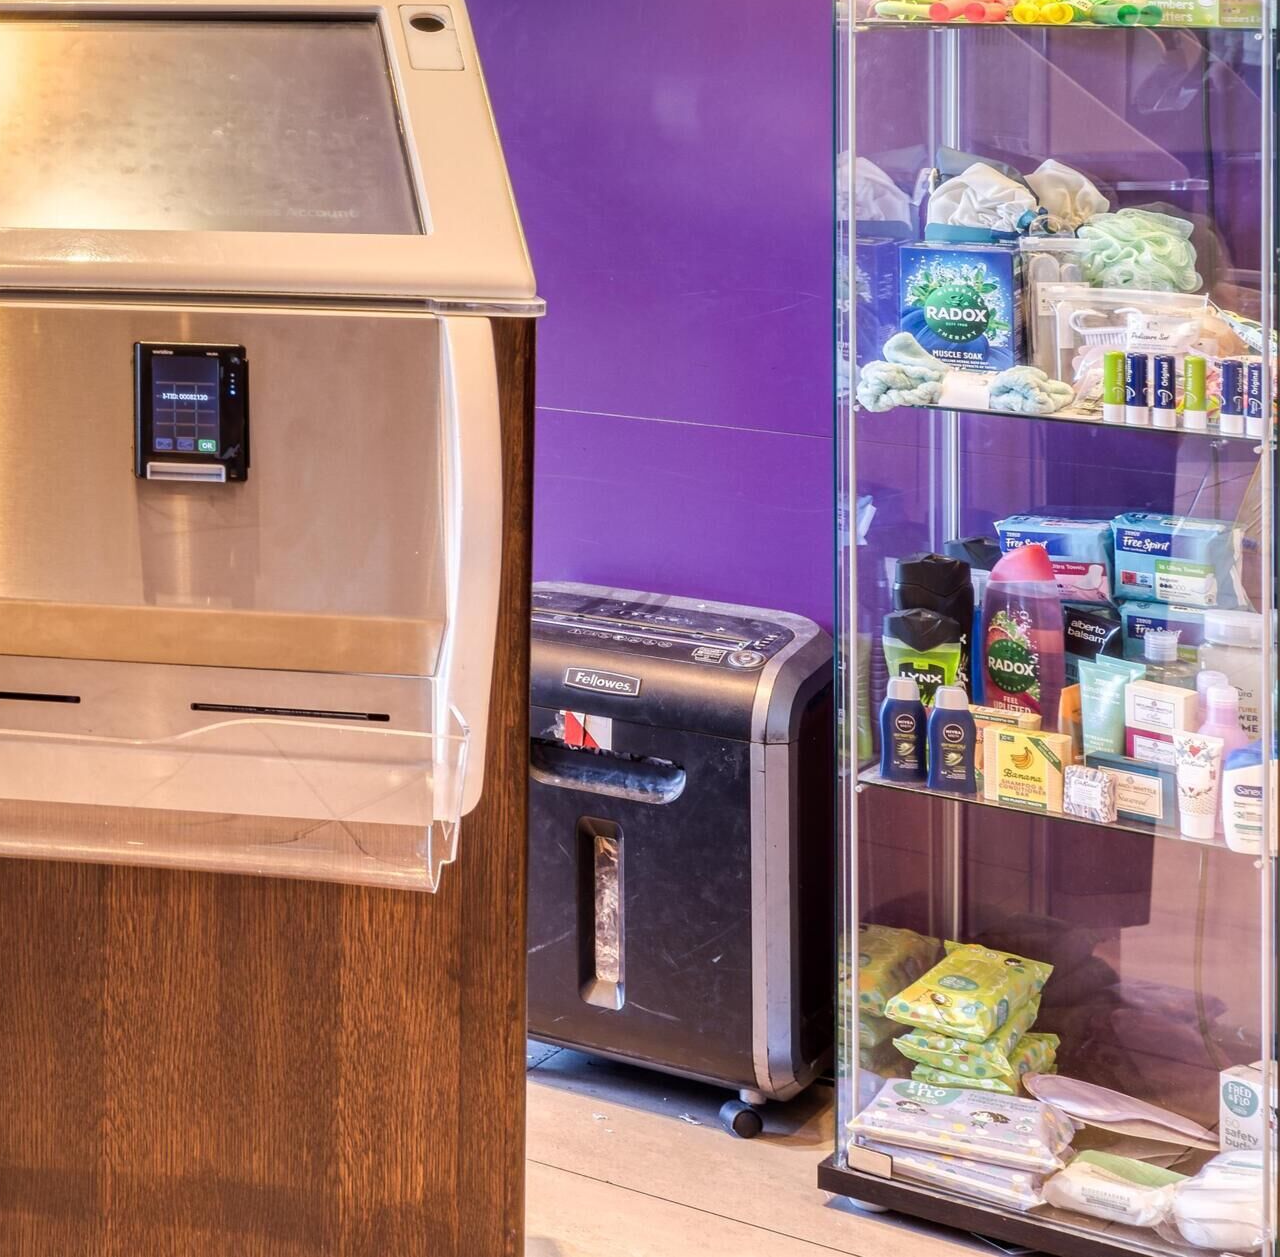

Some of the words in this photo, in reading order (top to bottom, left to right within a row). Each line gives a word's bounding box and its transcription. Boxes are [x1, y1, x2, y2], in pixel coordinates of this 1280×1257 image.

[926, 305, 989, 323] RADOX
[932, 349, 962, 359] MUSCLE
[963, 352, 983, 361] SOAK
[202, 441, 213, 449] OK
[1122, 536, 1143, 548] Free
[1143, 539, 1170, 551] Spirit
[1070, 620, 1106, 635] alberto
[1067, 627, 1106, 645] balsam
[988, 655, 1035, 677] RADOX
[900, 671, 942, 684] LYNX
[1003, 695, 1019, 705] FEEL
[1003, 768, 1042, 783] Banana
[999, 783, 1046, 796] CONDITIONER
[1002, 778, 1037, 790] SHAMPOO
[917, 1084, 946, 1098] FLO
[1228, 1082, 1252, 1099] FRED
[1234, 1094, 1251, 1107] FLO
[1224, 1127, 1259, 1146] safety
[1224, 1136, 1253, 1151] buds
